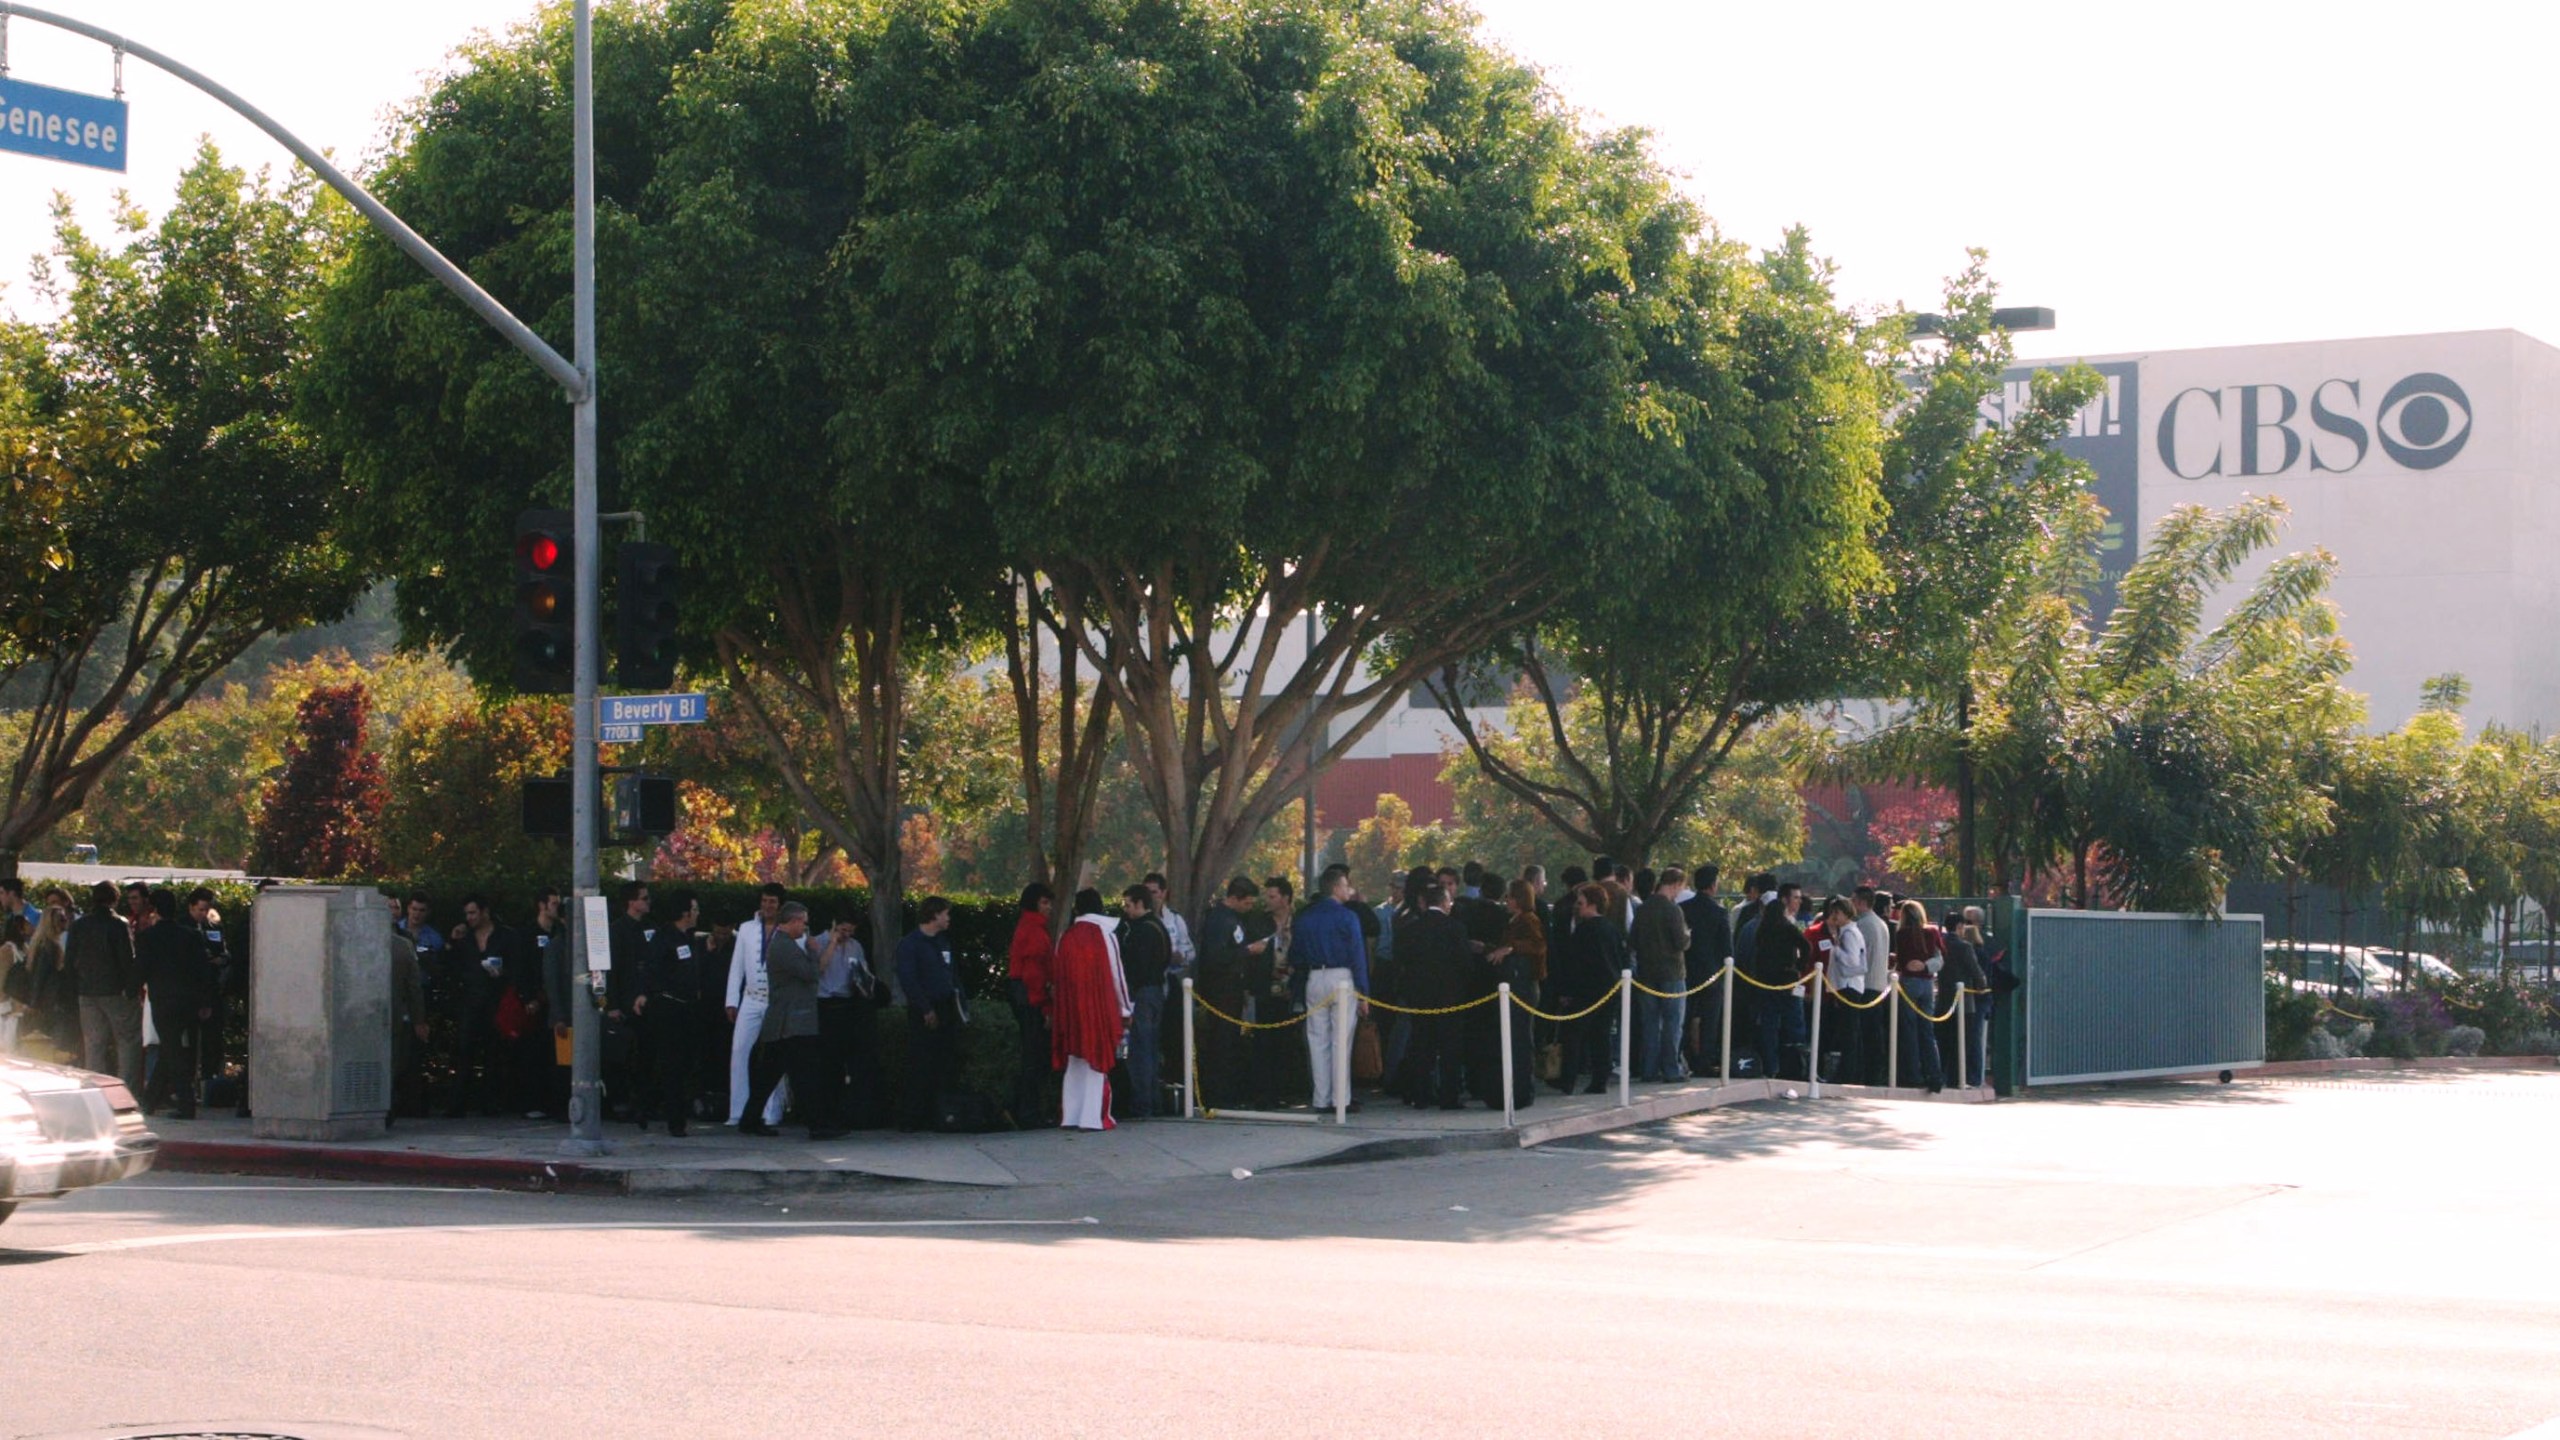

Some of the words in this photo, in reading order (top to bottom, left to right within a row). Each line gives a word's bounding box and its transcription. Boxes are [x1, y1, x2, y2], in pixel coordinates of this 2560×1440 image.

[2157, 378, 2369, 480] CBS
[613, 699, 672, 722] Beverly
[604, 726, 629, 739] 7700
[631, 726, 640, 738] W
